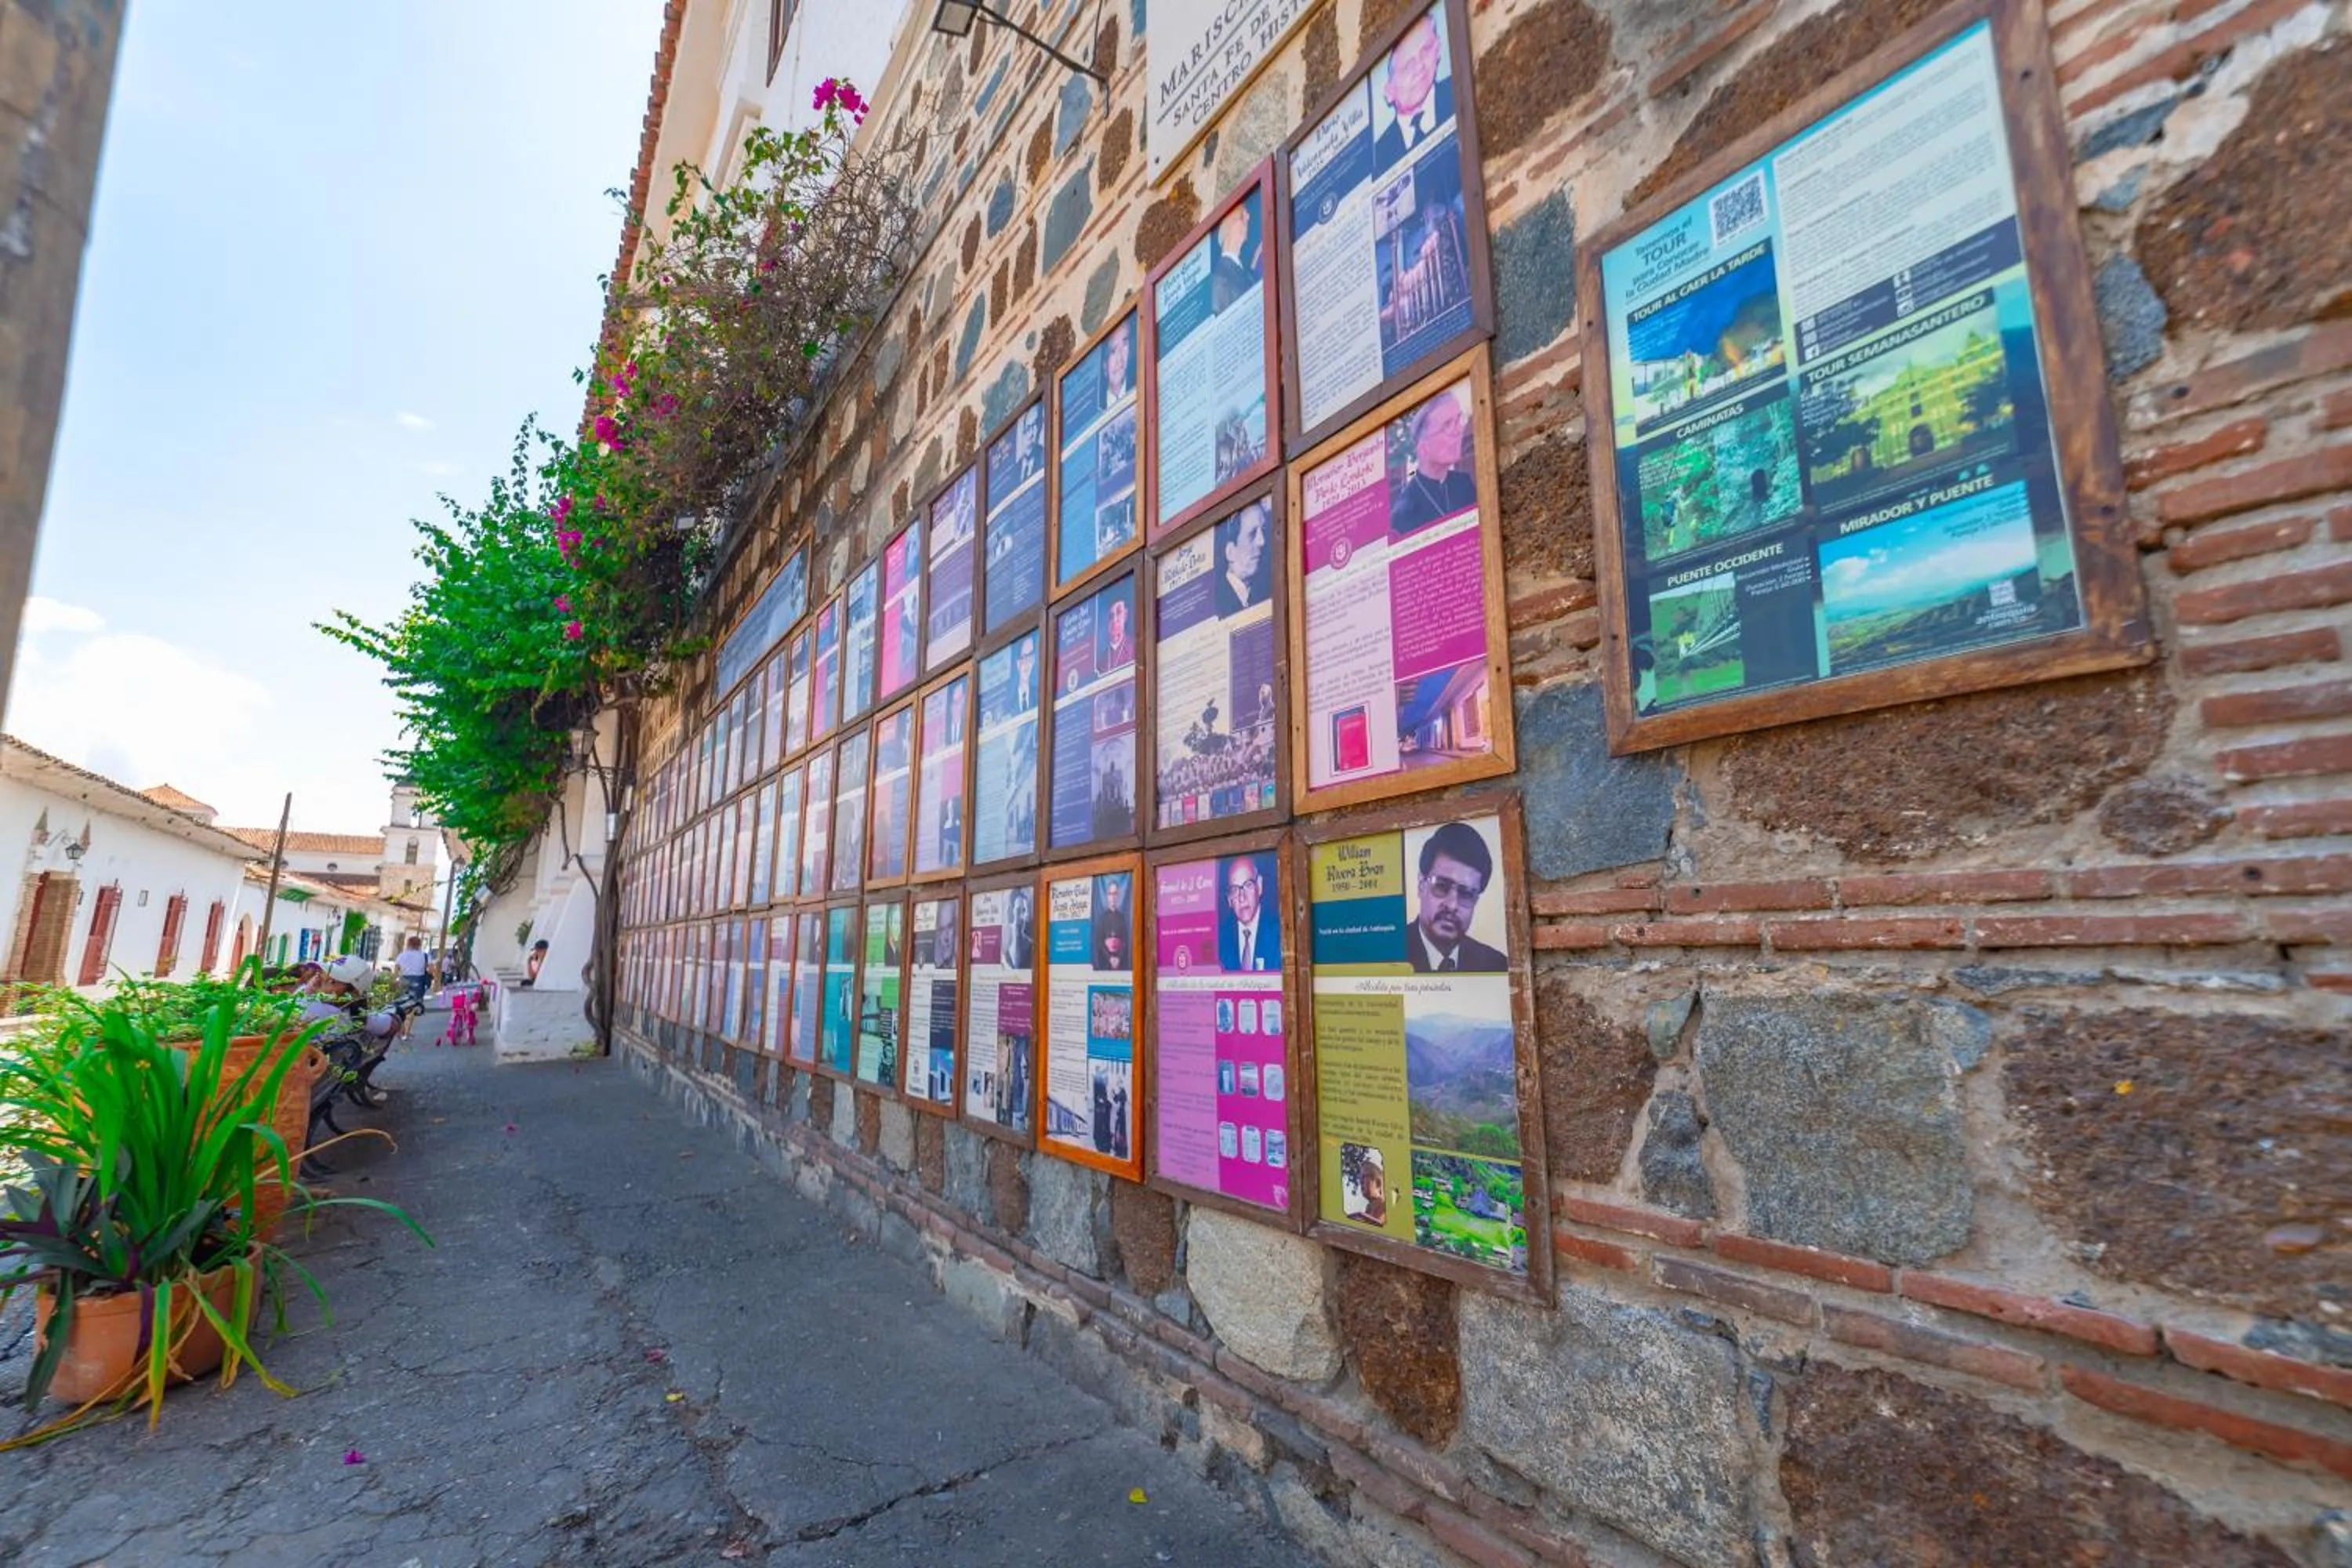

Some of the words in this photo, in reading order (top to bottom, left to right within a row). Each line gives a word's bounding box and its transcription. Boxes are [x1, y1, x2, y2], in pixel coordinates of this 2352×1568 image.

[1160, 0, 1243, 107] MARISC
[1174, 68, 1219, 127] SANTA
[1224, 35, 1245, 66] FE
[1250, 4, 1270, 38] DE
[1192, 51, 1252, 125] CENTRO
[1260, 0, 1306, 52] HIST
[1633, 298, 1663, 323] TOUR
[1664, 292, 1679, 307] AL
[1679, 277, 1709, 296] CAER
[1711, 267, 1726, 281] LA
[1727, 243, 1765, 272] TARDE
[1636, 267, 1671, 292] Ciudad
[1641, 234, 1687, 266] TOUR
[1807, 357, 1846, 383] TOUR
[1847, 293, 1986, 364] SEMANASANTERO
[1676, 403, 1745, 439] CAMINATAS
[1839, 501, 1915, 535] MIRADOR
[1916, 497, 1929, 510] Y
[1929, 474, 1995, 506] PUENTE
[1667, 564, 1712, 587] PUENTE
[1714, 542, 1784, 573] OCCIDENTE
